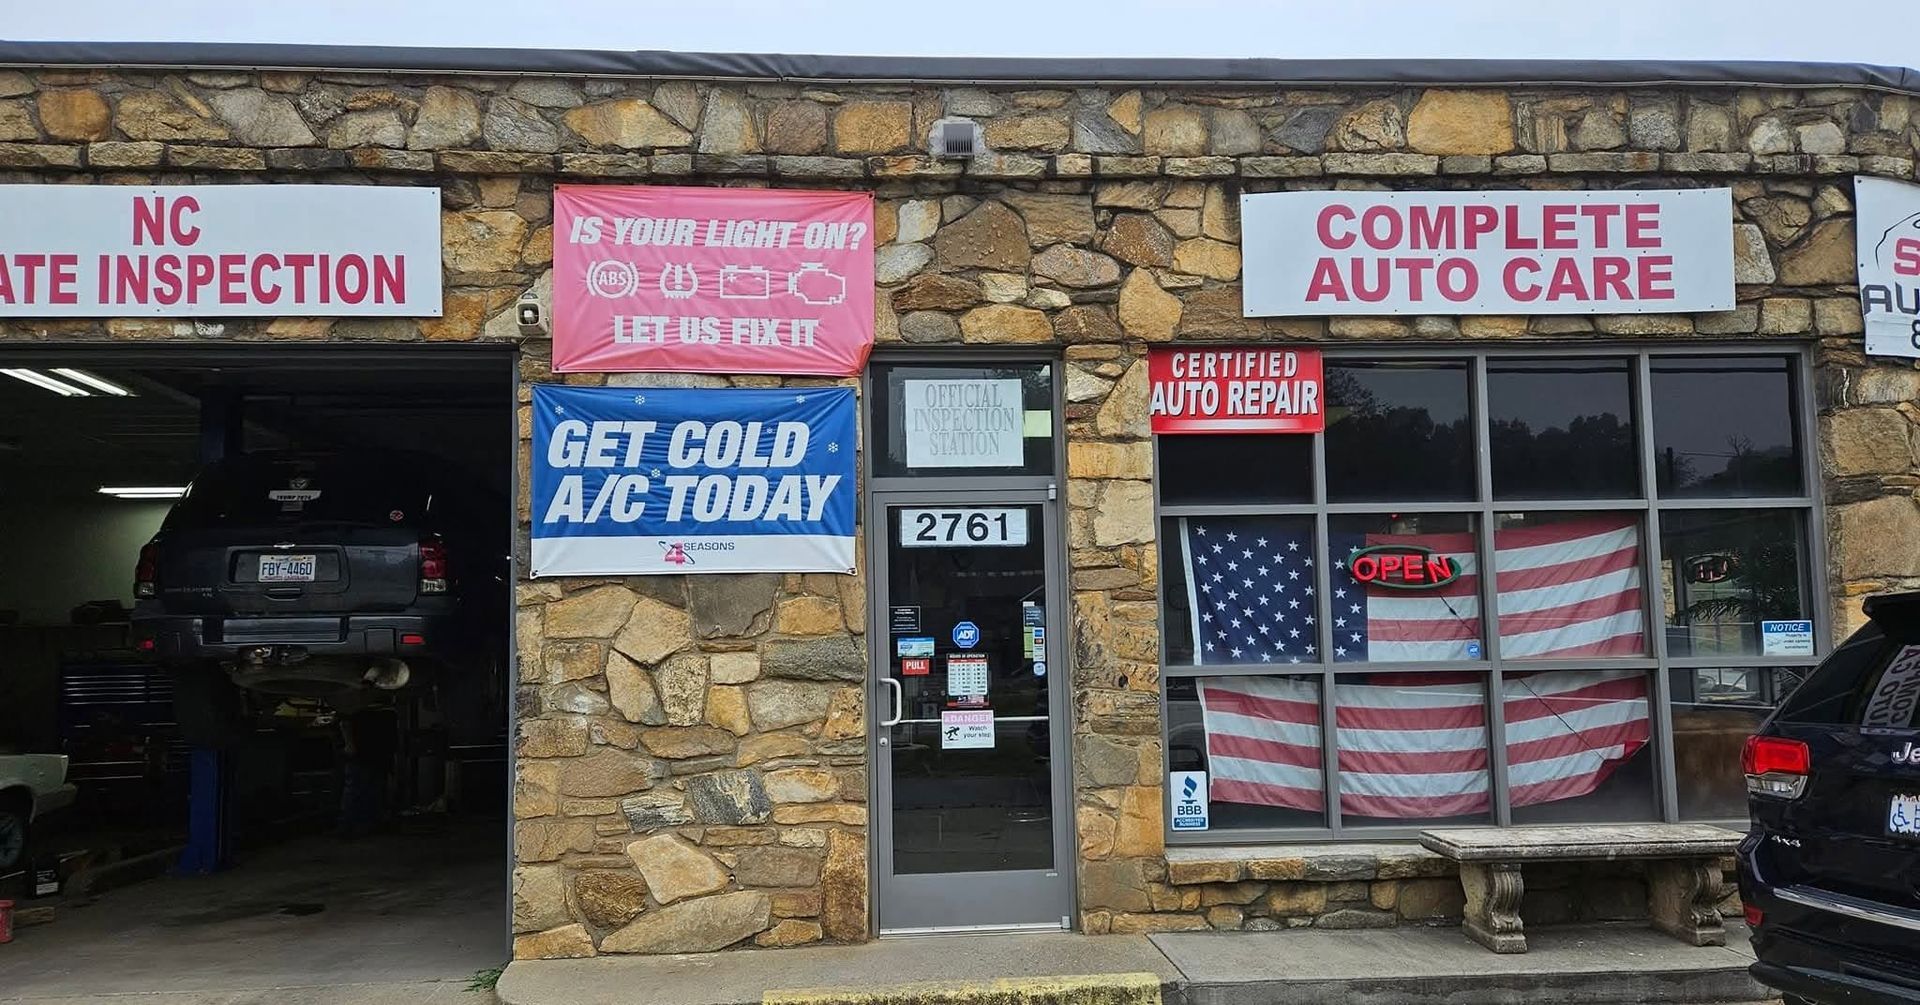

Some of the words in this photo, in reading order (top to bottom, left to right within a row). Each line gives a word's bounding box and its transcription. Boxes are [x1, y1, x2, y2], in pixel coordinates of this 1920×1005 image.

[133, 195, 201, 247] NC
[570, 216, 603, 244] IS
[614, 218, 697, 247] YOUR
[705, 220, 797, 249] LIGHT
[804, 222, 867, 250] ON?
[1316, 204, 1662, 250] COMPLETE
[99, 253, 406, 306] INSPECTION
[599, 271, 627, 286] ABS
[1305, 256, 1479, 302] AUTO
[1502, 255, 1675, 301] CARE
[614, 315, 670, 344] LET
[679, 316, 721, 344] US
[732, 318, 782, 346] FIX
[791, 319, 819, 347] IT
[1172, 352, 1297, 378] CERTIFIED
[925, 384, 1003, 408] OFFICIAL
[1150, 381, 1220, 416] AUTO
[1227, 380, 1318, 415] REPAIR
[913, 408, 1015, 432] INSPECTION
[547, 420, 657, 468] GET
[667, 420, 810, 469] COLD
[929, 432, 1000, 456] STATION
[543, 474, 650, 524] A/C
[664, 474, 841, 523] TODAY
[916, 513, 1008, 541] 2761
[683, 542, 735, 551] SEASONS
[262, 562, 313, 576] FBY-4460
[1353, 555, 1452, 583] OPEN
[957, 630, 976, 640] ADT
[1770, 623, 1805, 632] NOTICE
[906, 660, 926, 671] PULL
[950, 714, 992, 723] DANGER
[1177, 805, 1202, 816] BBB
